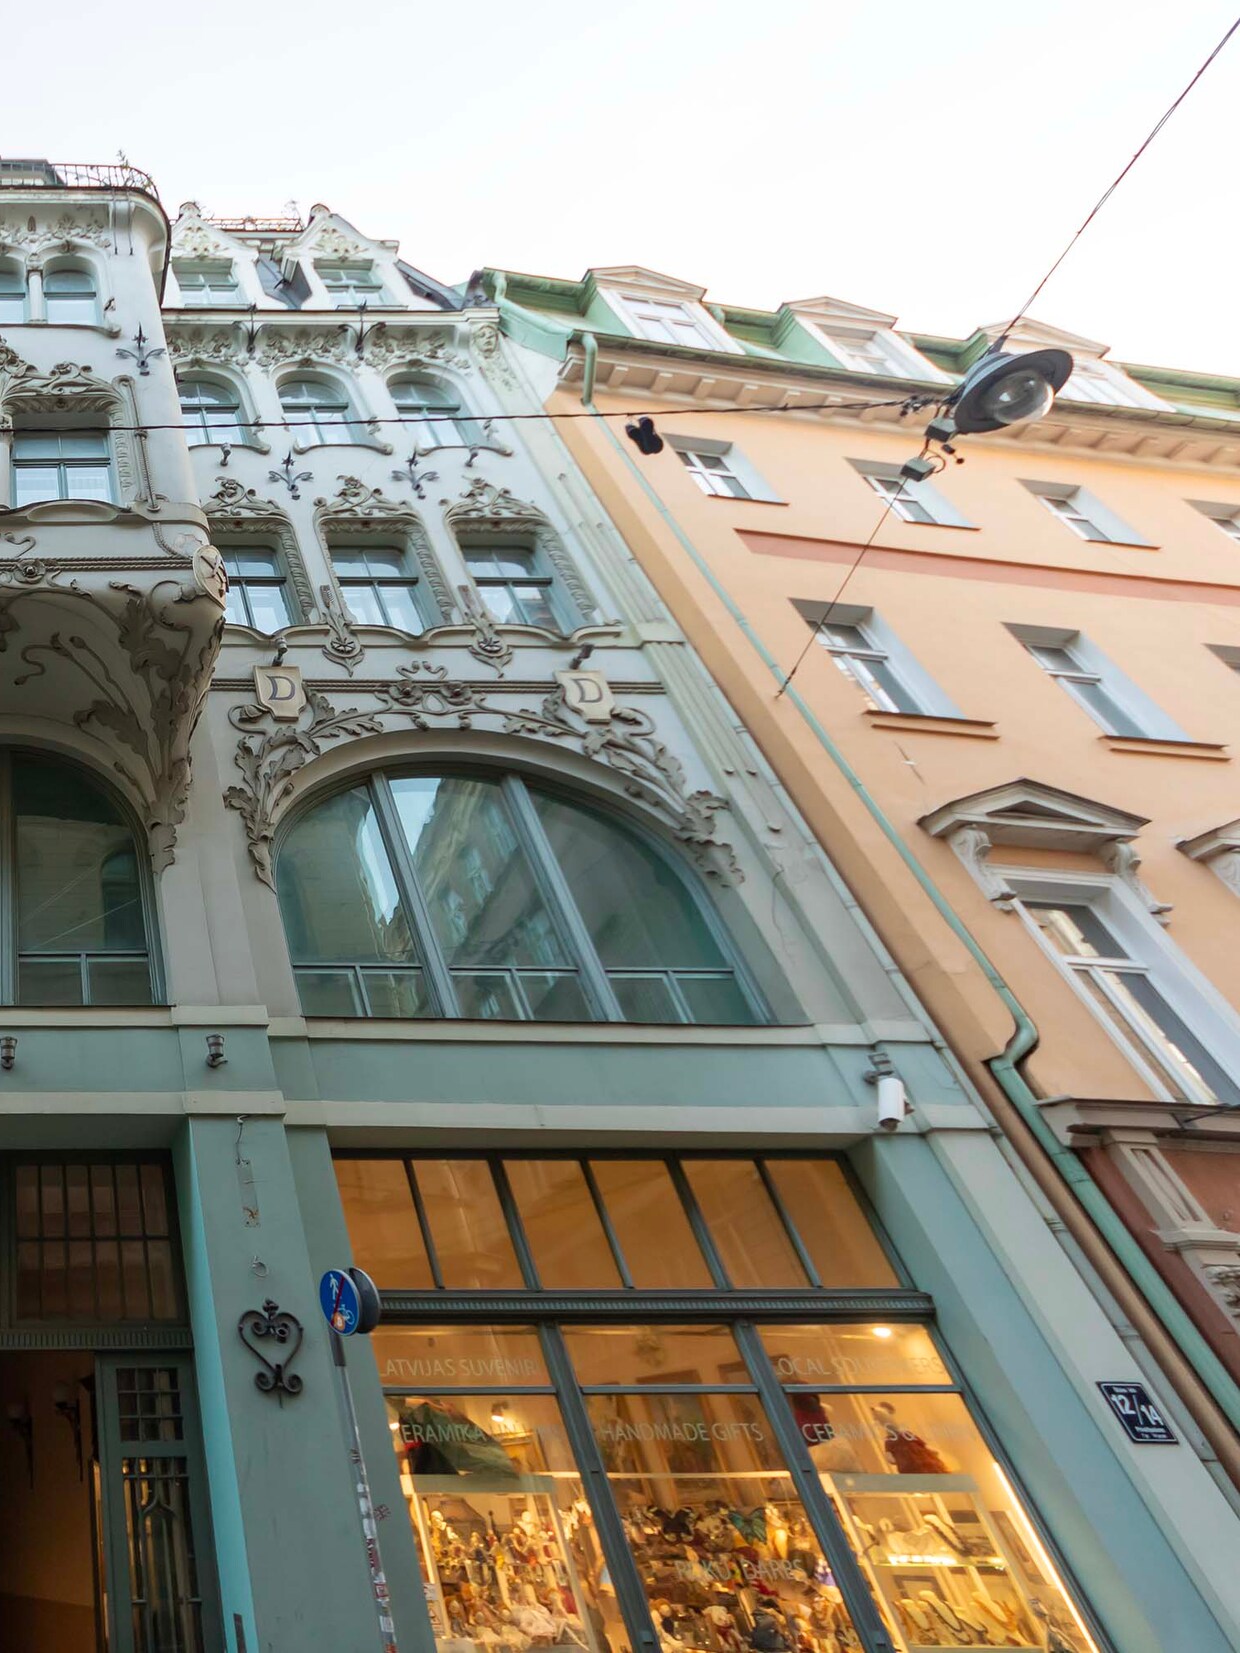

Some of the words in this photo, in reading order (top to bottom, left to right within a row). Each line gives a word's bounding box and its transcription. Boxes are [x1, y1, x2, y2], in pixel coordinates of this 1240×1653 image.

[266, 674, 297, 702] D
[571, 677, 604, 704] D
[394, 1423, 488, 1444] ERAMIKA
[600, 1422, 711, 1442] HANDMADE
[711, 1422, 765, 1442] GIFTS
